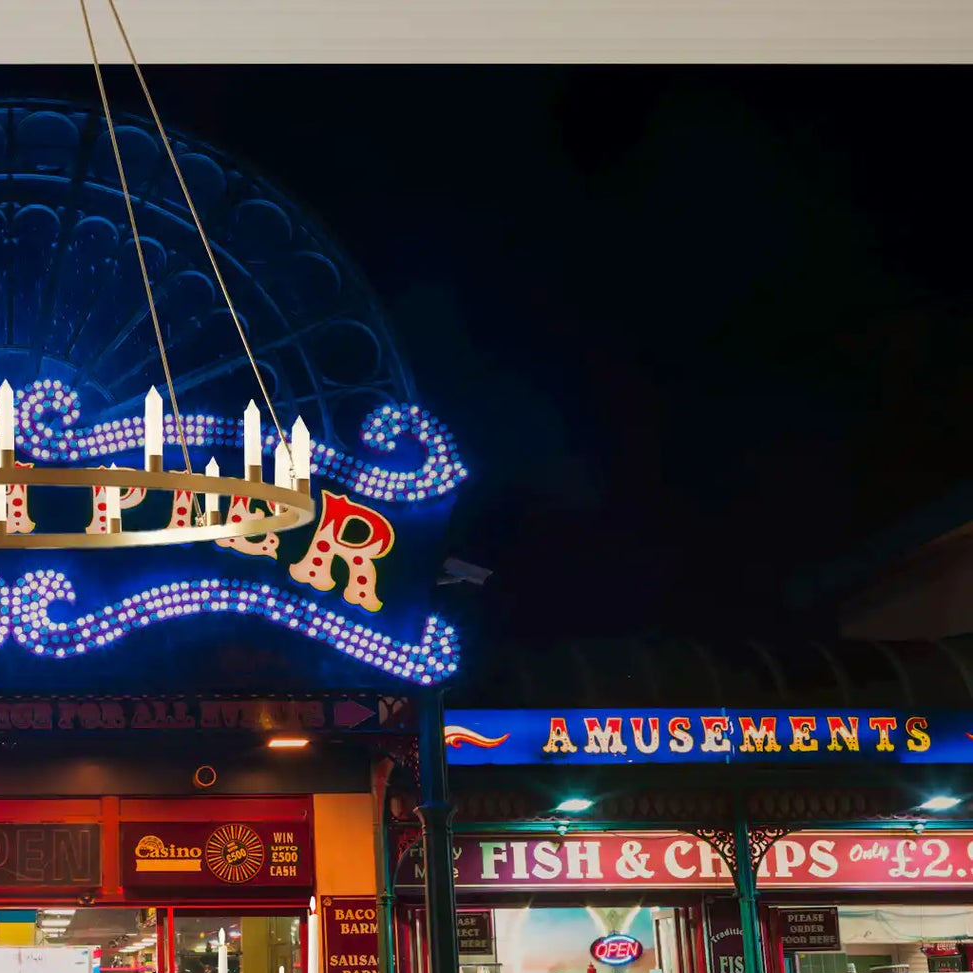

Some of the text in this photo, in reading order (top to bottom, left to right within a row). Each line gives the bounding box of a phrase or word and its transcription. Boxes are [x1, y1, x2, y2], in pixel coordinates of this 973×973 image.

[58, 701, 126, 730] FOR
[130, 701, 196, 730] ALL
[542, 716, 931, 754] AMUSEMENTS
[273, 832, 294, 843] WIN
[135, 844, 202, 858] Casino
[226, 848, 247, 863] £500
[271, 852, 298, 863] £500
[479, 841, 604, 879] FISH
[615, 841, 655, 879] &
[849, 842, 890, 861] Only
[888, 839, 973, 878] £2.
[270, 866, 297, 876] CASH
[334, 909, 377, 921] BACO
[787, 914, 824, 922] PLEASE
[790, 925, 824, 933] ORDER
[595, 942, 639, 958] OPEN
[329, 954, 395, 966] SAUSA
